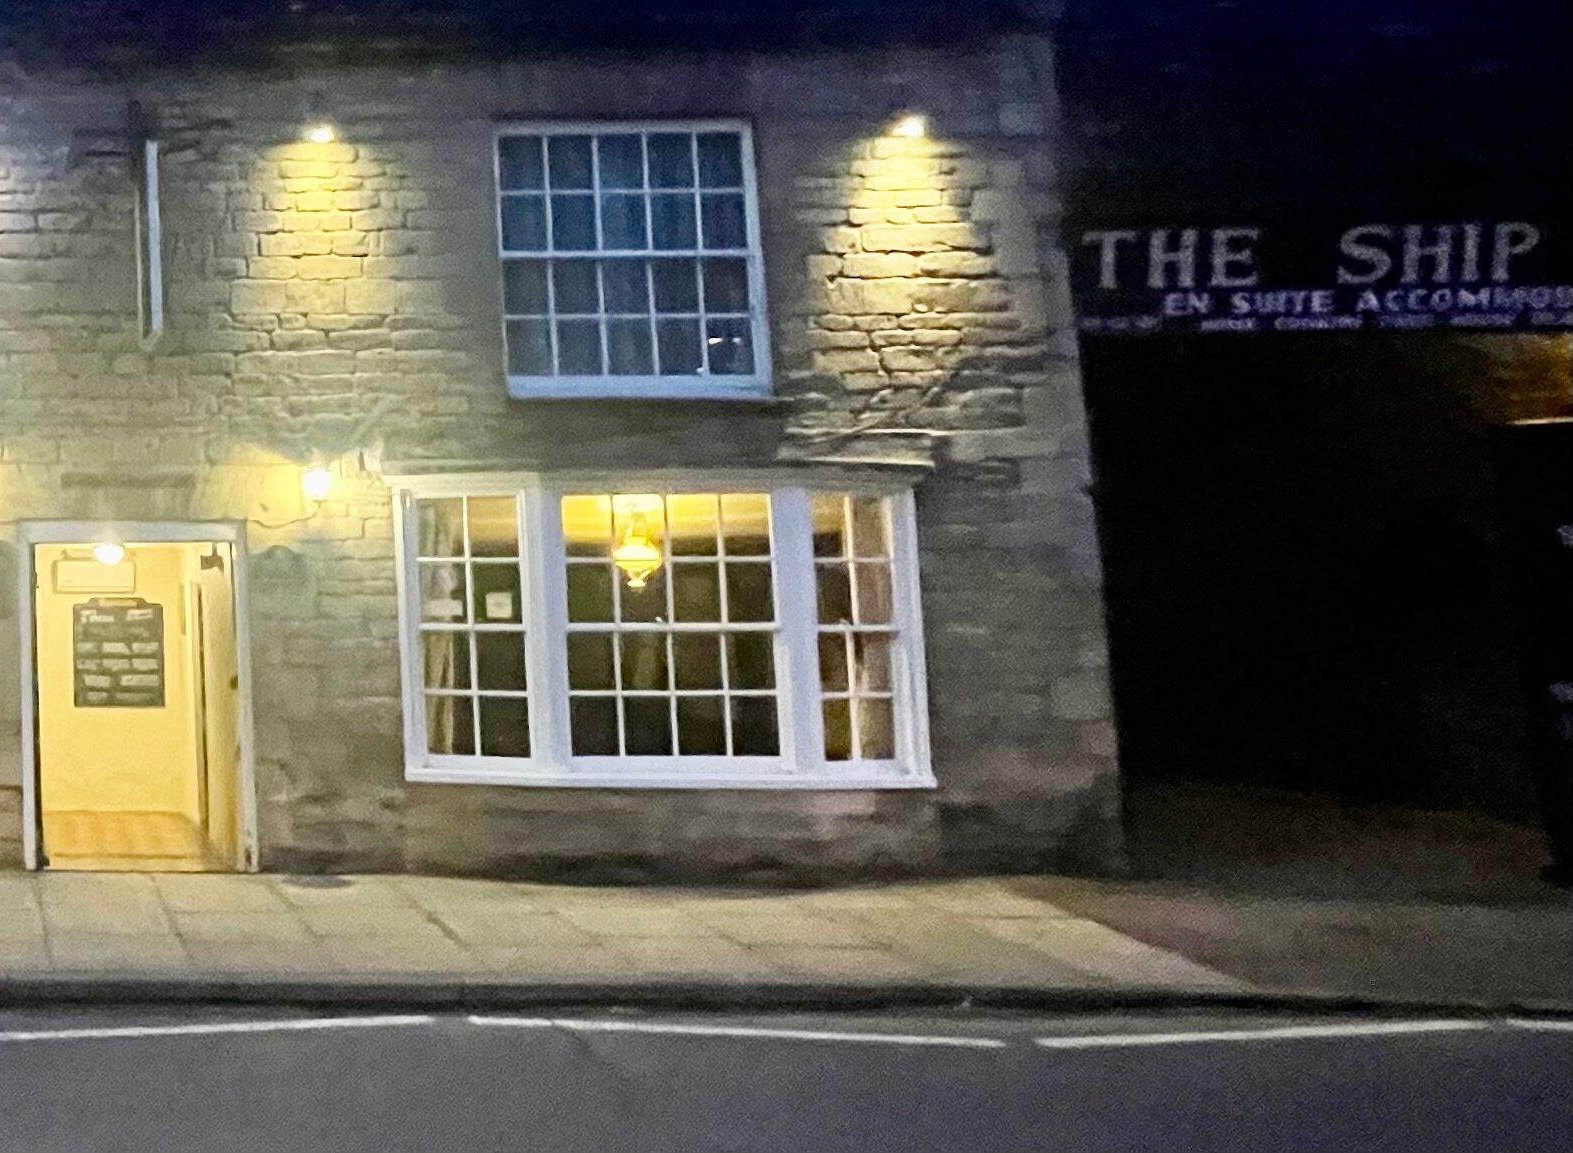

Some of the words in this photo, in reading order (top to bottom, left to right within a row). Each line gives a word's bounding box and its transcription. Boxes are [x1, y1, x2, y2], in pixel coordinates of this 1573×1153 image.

[1081, 227, 1260, 289] THE
[1337, 221, 1540, 284] SHIP
[1163, 291, 1211, 316] EN
[1230, 289, 1334, 314] SUITE
